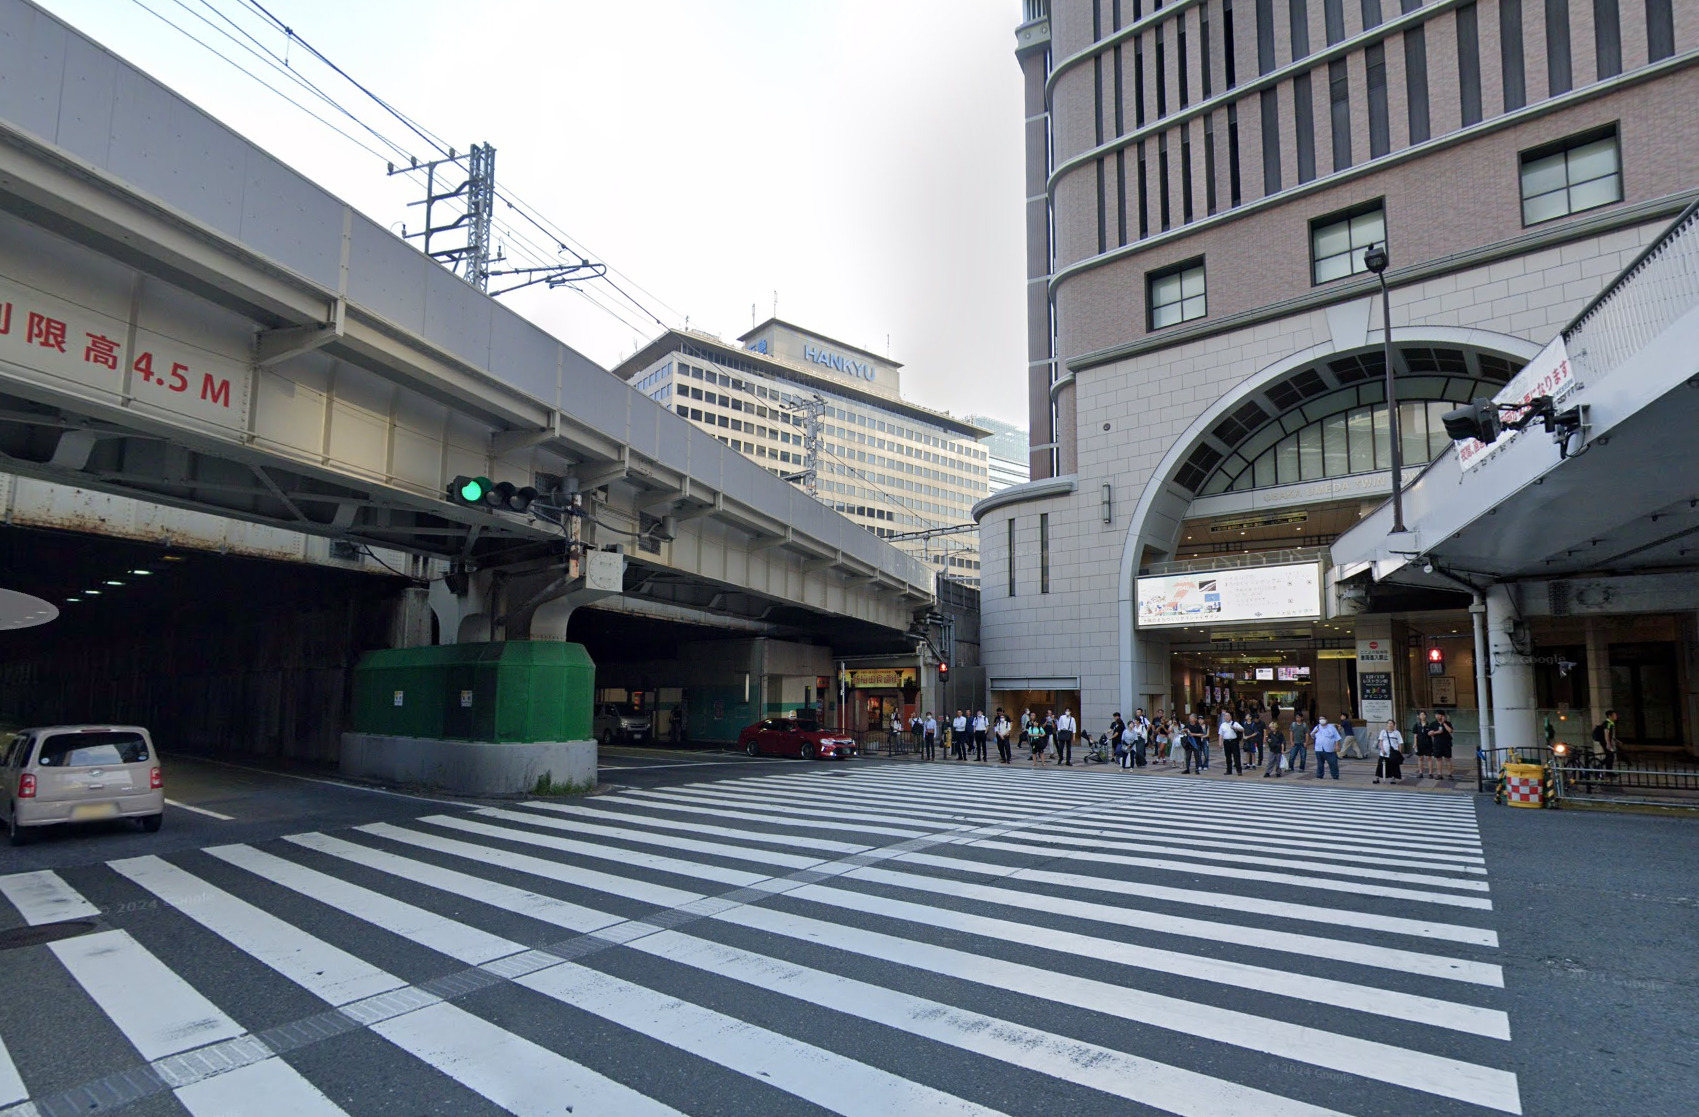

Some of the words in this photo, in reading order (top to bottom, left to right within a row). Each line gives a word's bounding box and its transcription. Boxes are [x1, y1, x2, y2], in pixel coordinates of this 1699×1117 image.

[804, 344, 876, 382] HANKYU
[1263, 490, 1303, 503] OSAKA
[1306, 481, 1350, 497] UMEDA
[1354, 476, 1387, 489] TWIN
